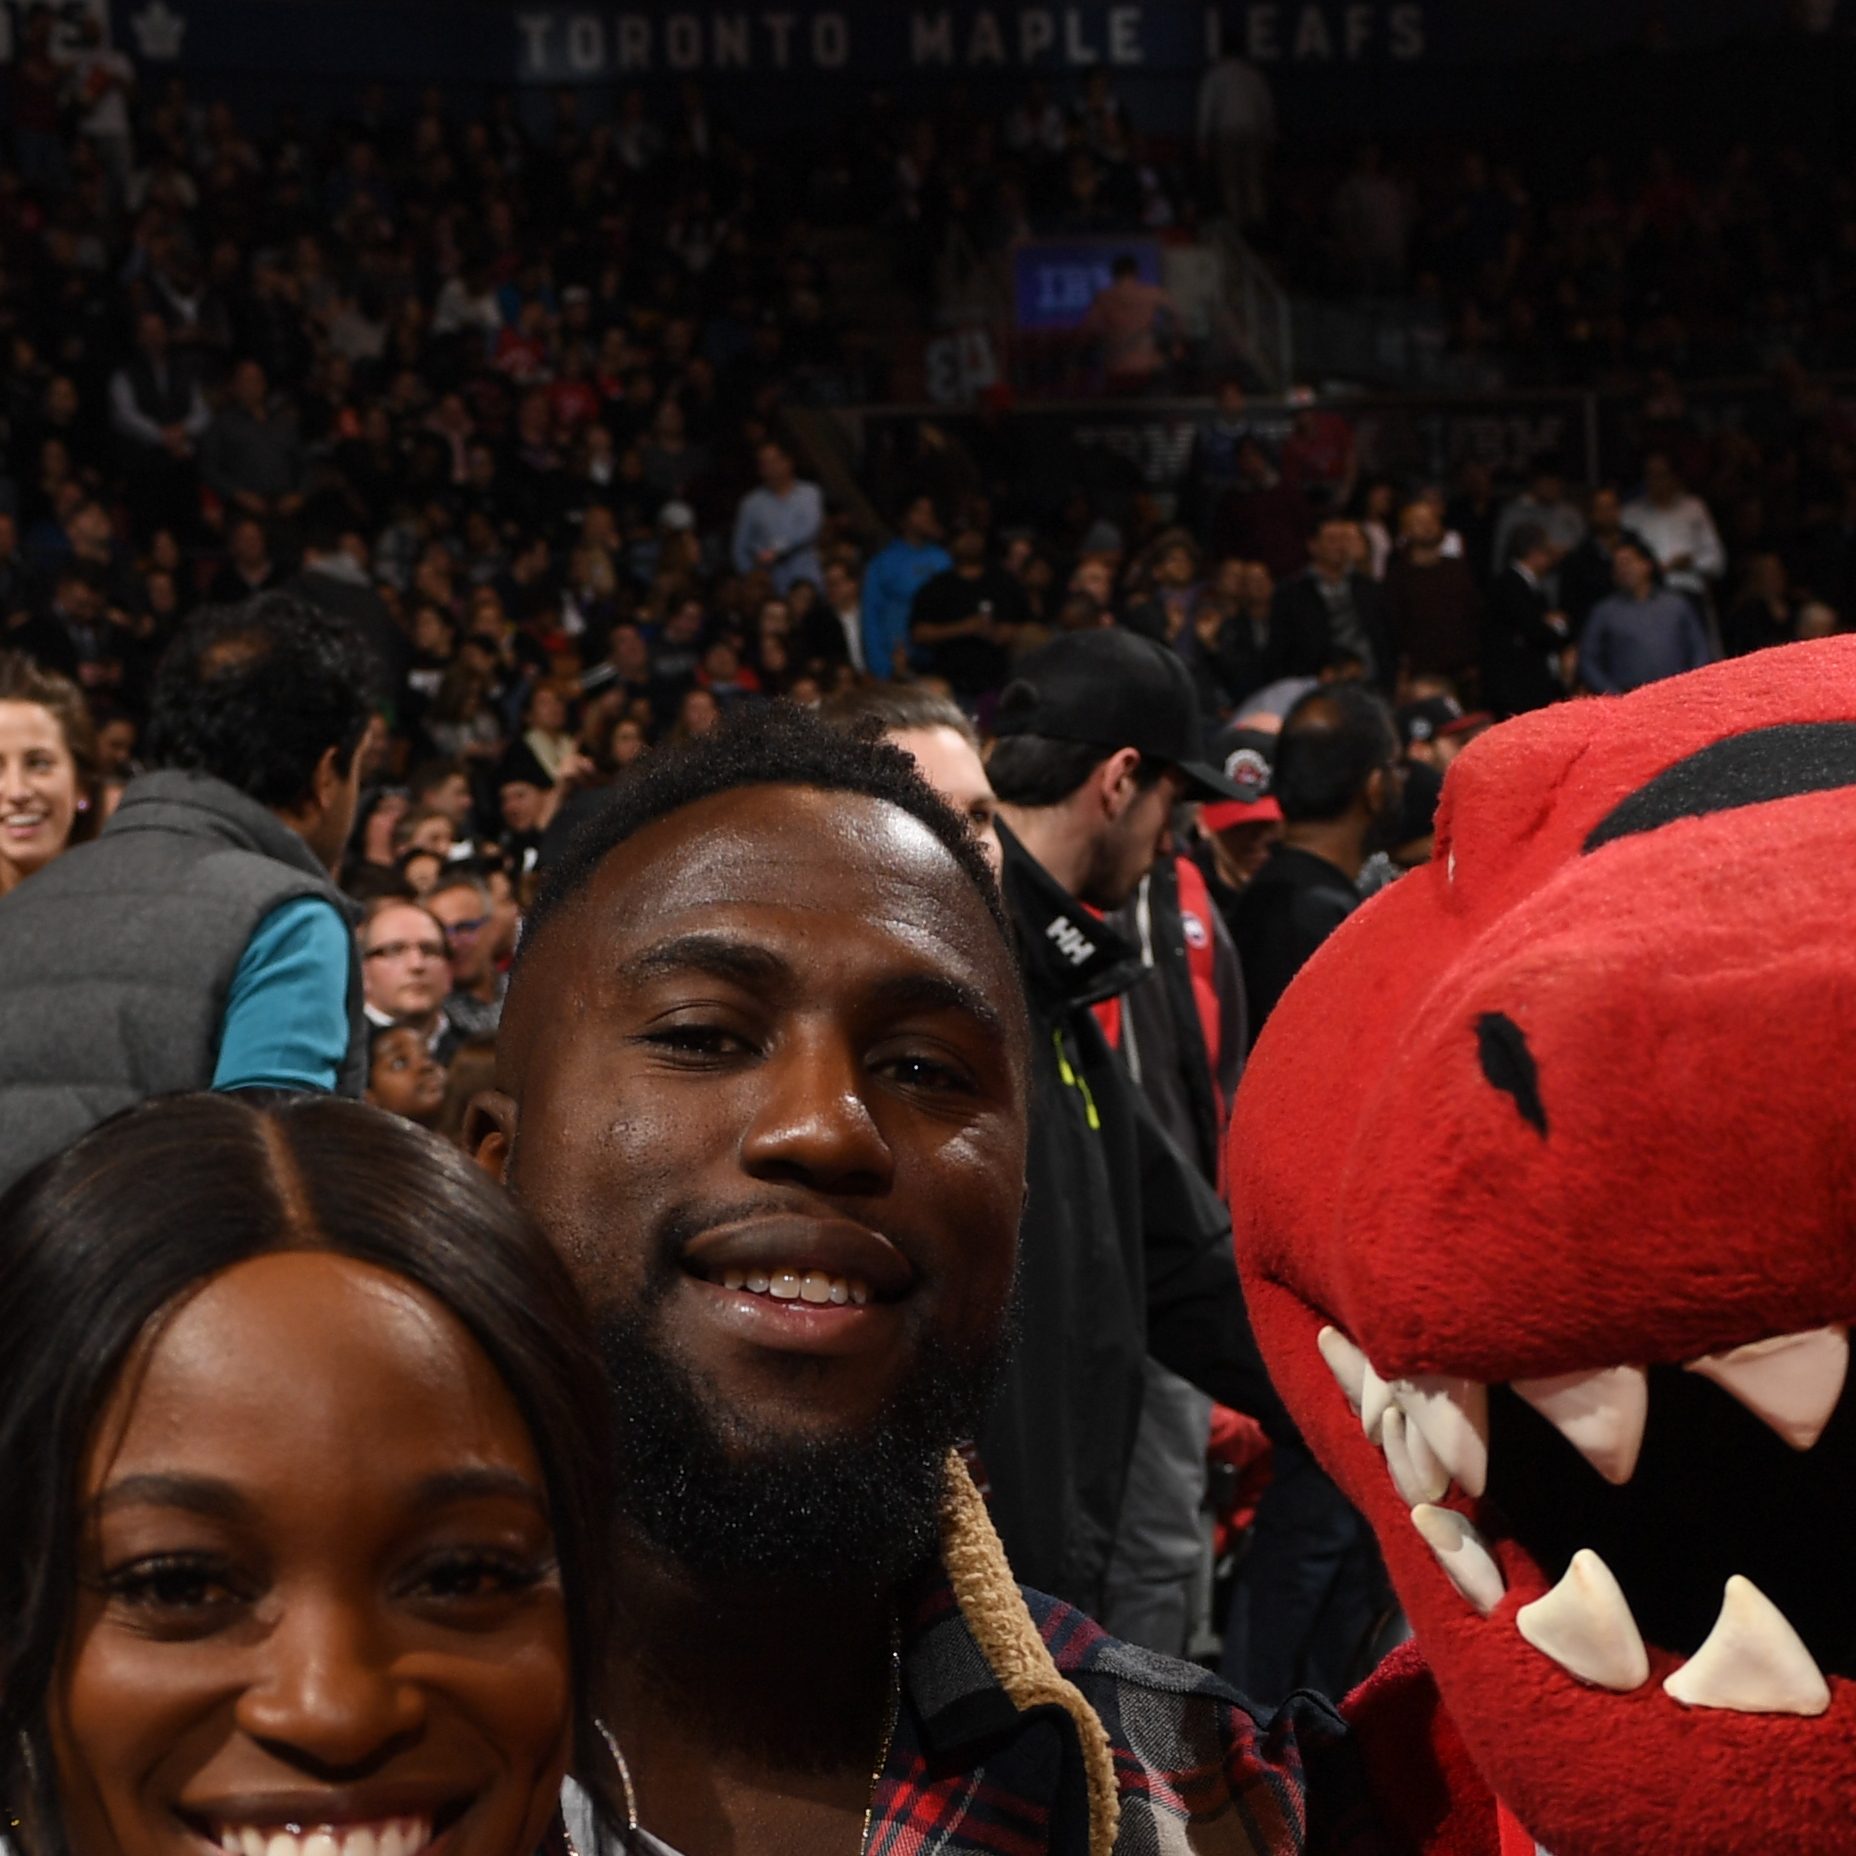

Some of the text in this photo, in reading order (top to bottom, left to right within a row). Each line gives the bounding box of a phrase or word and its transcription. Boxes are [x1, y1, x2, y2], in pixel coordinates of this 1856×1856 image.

[517, 5, 1427, 71] TORONTO MAPLE LEAFS
